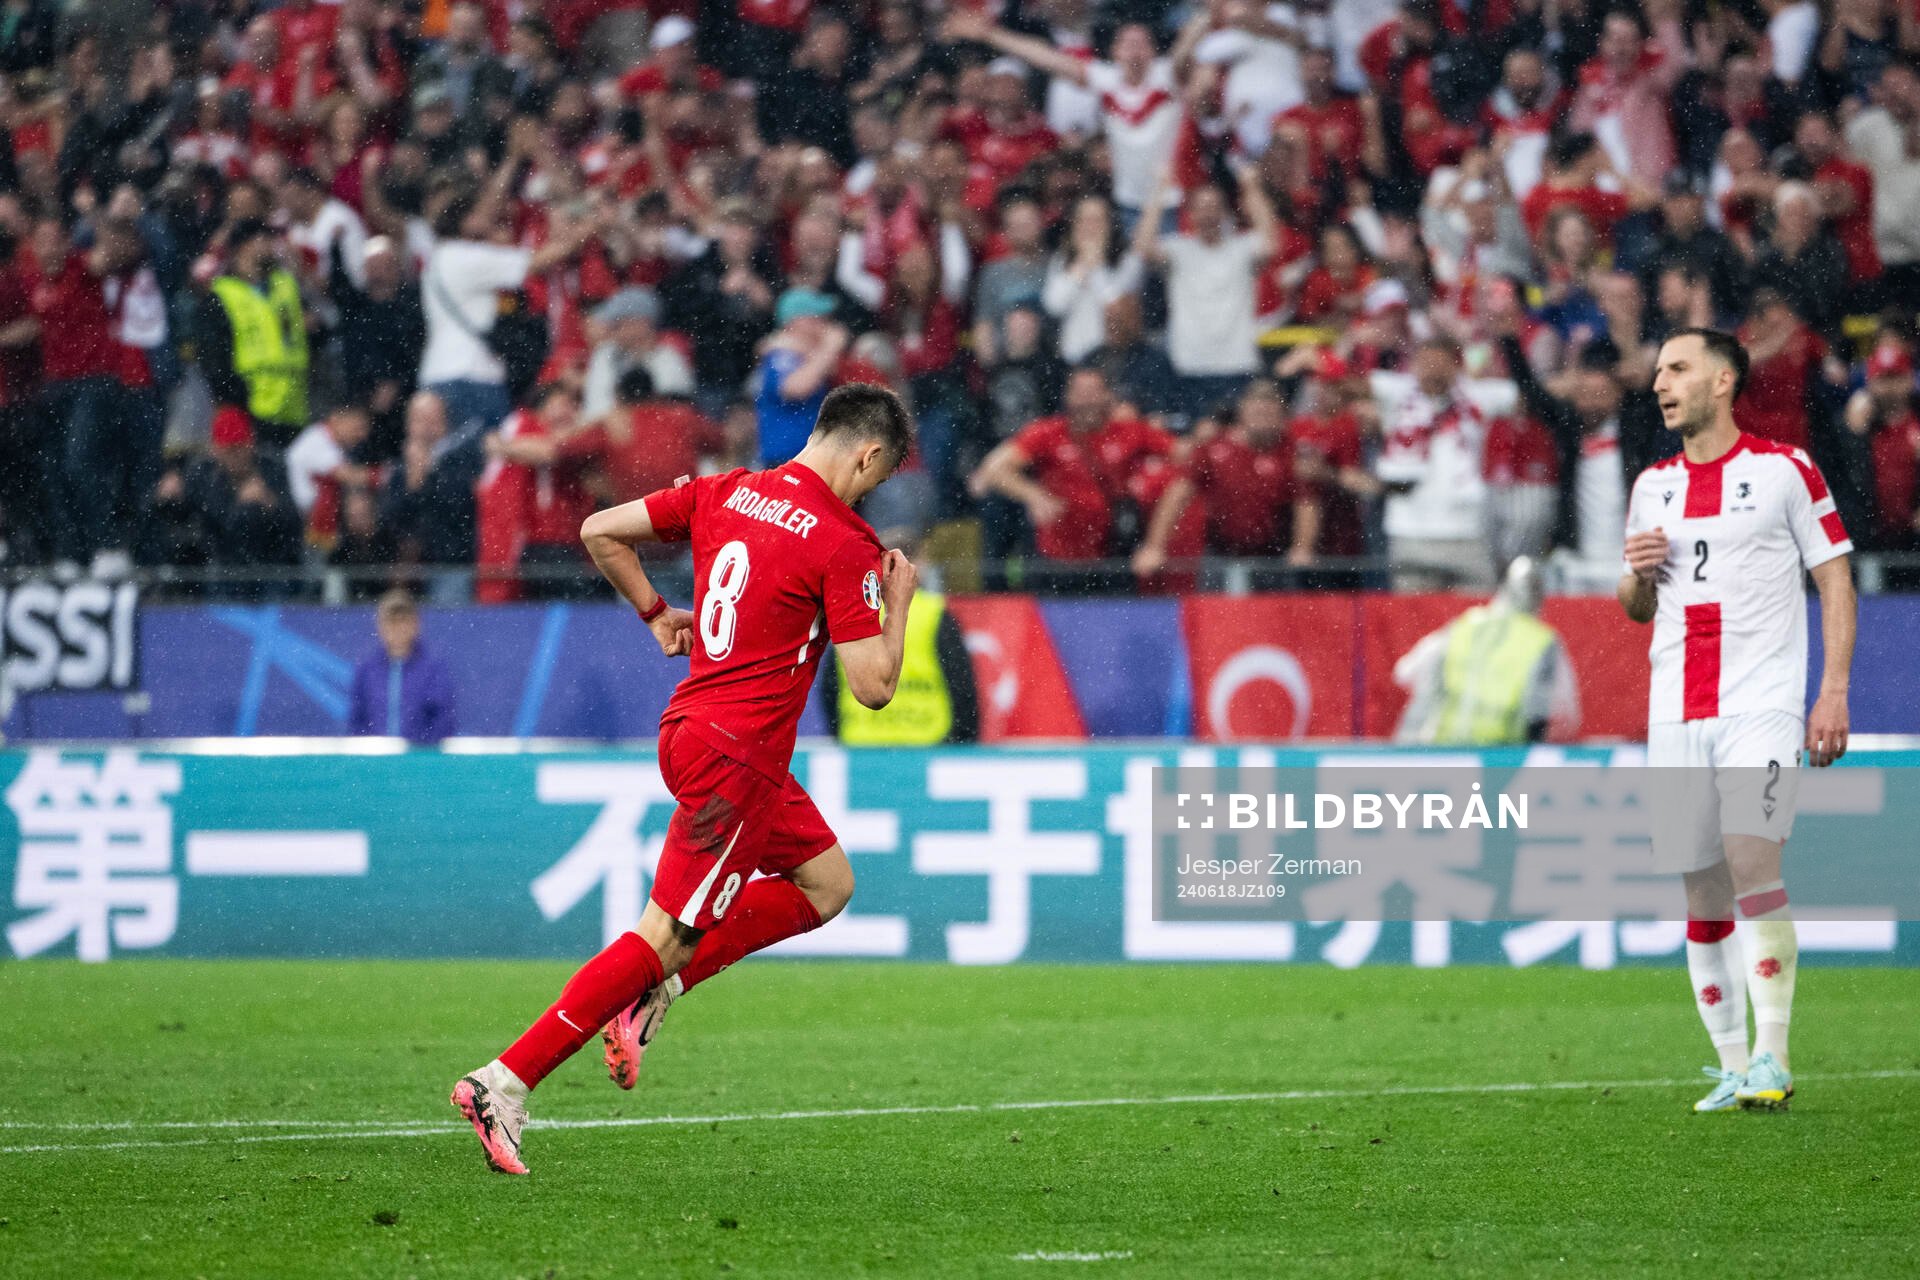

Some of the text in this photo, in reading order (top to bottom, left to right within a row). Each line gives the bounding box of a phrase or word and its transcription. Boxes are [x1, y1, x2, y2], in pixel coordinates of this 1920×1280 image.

[722, 486, 818, 539] ARDAGÜLER
[1693, 539, 1709, 583] 2
[700, 540, 750, 661] 8
[0, 583, 137, 688] SSI
[1763, 759, 1781, 802] 2
[5, 750, 369, 962] 第一
[712, 872, 741, 919] 8
